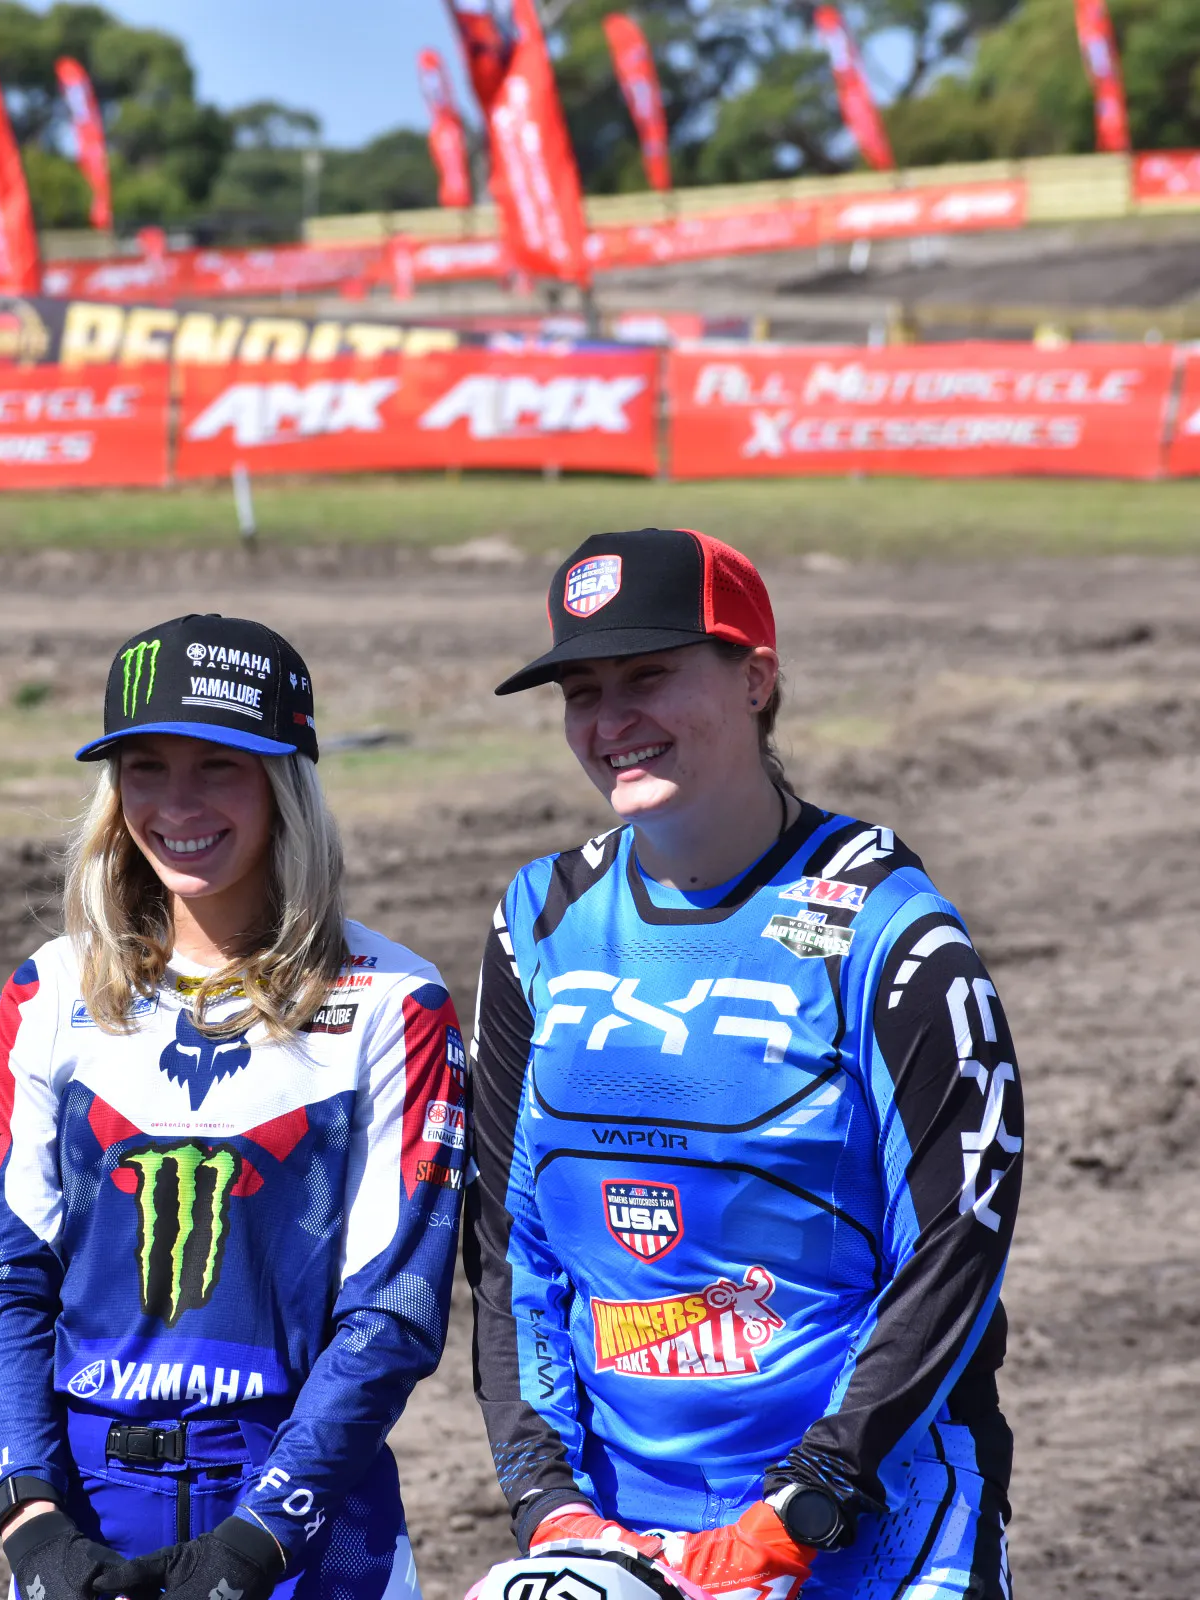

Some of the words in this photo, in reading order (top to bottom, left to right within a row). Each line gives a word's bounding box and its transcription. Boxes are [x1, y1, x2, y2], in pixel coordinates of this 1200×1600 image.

[185, 377, 399, 446] AMX
[417, 375, 647, 440] AMX
[568, 574, 616, 601] USA
[193, 661, 266, 679] RACING
[208, 645, 271, 674] YAMAHA
[190, 677, 262, 708] YAMALUBE
[784, 879, 864, 906] AMA
[531, 970, 801, 1063] FXR
[427, 1130, 464, 1147] FINANCIA
[592, 1128, 688, 1150] VAPOR
[629, 1196, 659, 1207] MOTOCROSS
[659, 1198, 675, 1208] TEAM
[609, 1205, 678, 1232] USA
[594, 1297, 707, 1359] WINNERS
[615, 1349, 651, 1373] TAKE
[650, 1310, 746, 1374] Y'ALL
[111, 1359, 264, 1407] YAMAHA
[255, 1467, 326, 1542] FOX
[721, 1571, 771, 1587] DIVISION
